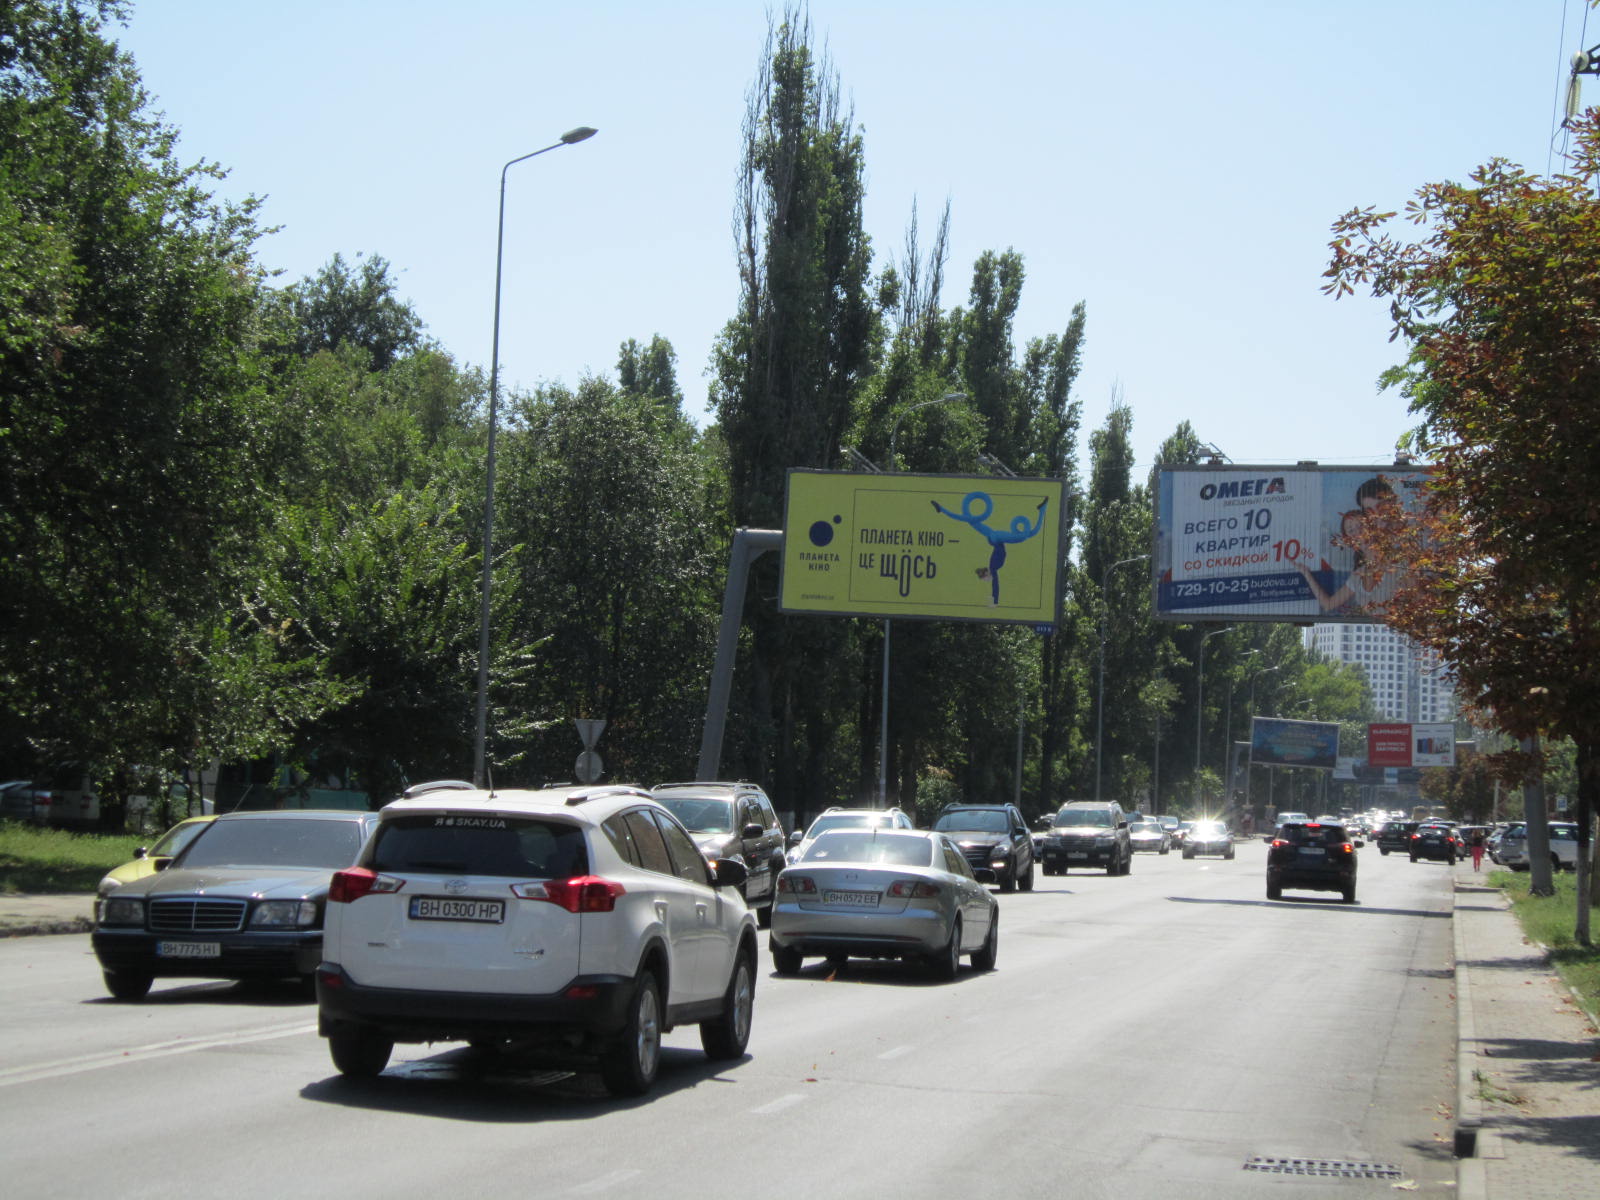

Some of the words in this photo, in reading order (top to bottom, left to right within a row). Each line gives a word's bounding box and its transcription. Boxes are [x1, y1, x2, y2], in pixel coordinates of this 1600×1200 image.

[1200, 477, 1286, 501] ОМЕГА
[1184, 517, 1238, 535] ВСЕГО
[1243, 508, 1272, 531] 10
[860, 528, 914, 546] ПЛАНЕТА
[918, 531, 945, 547] КІНО
[1195, 534, 1271, 554] КВАРТИР
[799, 552, 841, 562] ПЛАНЕТА
[859, 553, 875, 569] ЦЕ
[1184, 559, 1202, 571] СО
[1206, 553, 1269, 570] СКИДКОЙ
[1272, 539, 1315, 562] 10%
[809, 563, 830, 572] КІНО
[1176, 579, 1249, 597] 729-10-25
[434, 818, 444, 826] Я
[456, 817, 506, 829] SKAY.UA
[829, 894, 843, 903] BH
[844, 894, 863, 903] 0572
[864, 895, 878, 904] EE
[420, 900, 440, 916] BH
[442, 901, 476, 917] 0300
[479, 903, 500, 918] HP
[163, 943, 177, 953] BH
